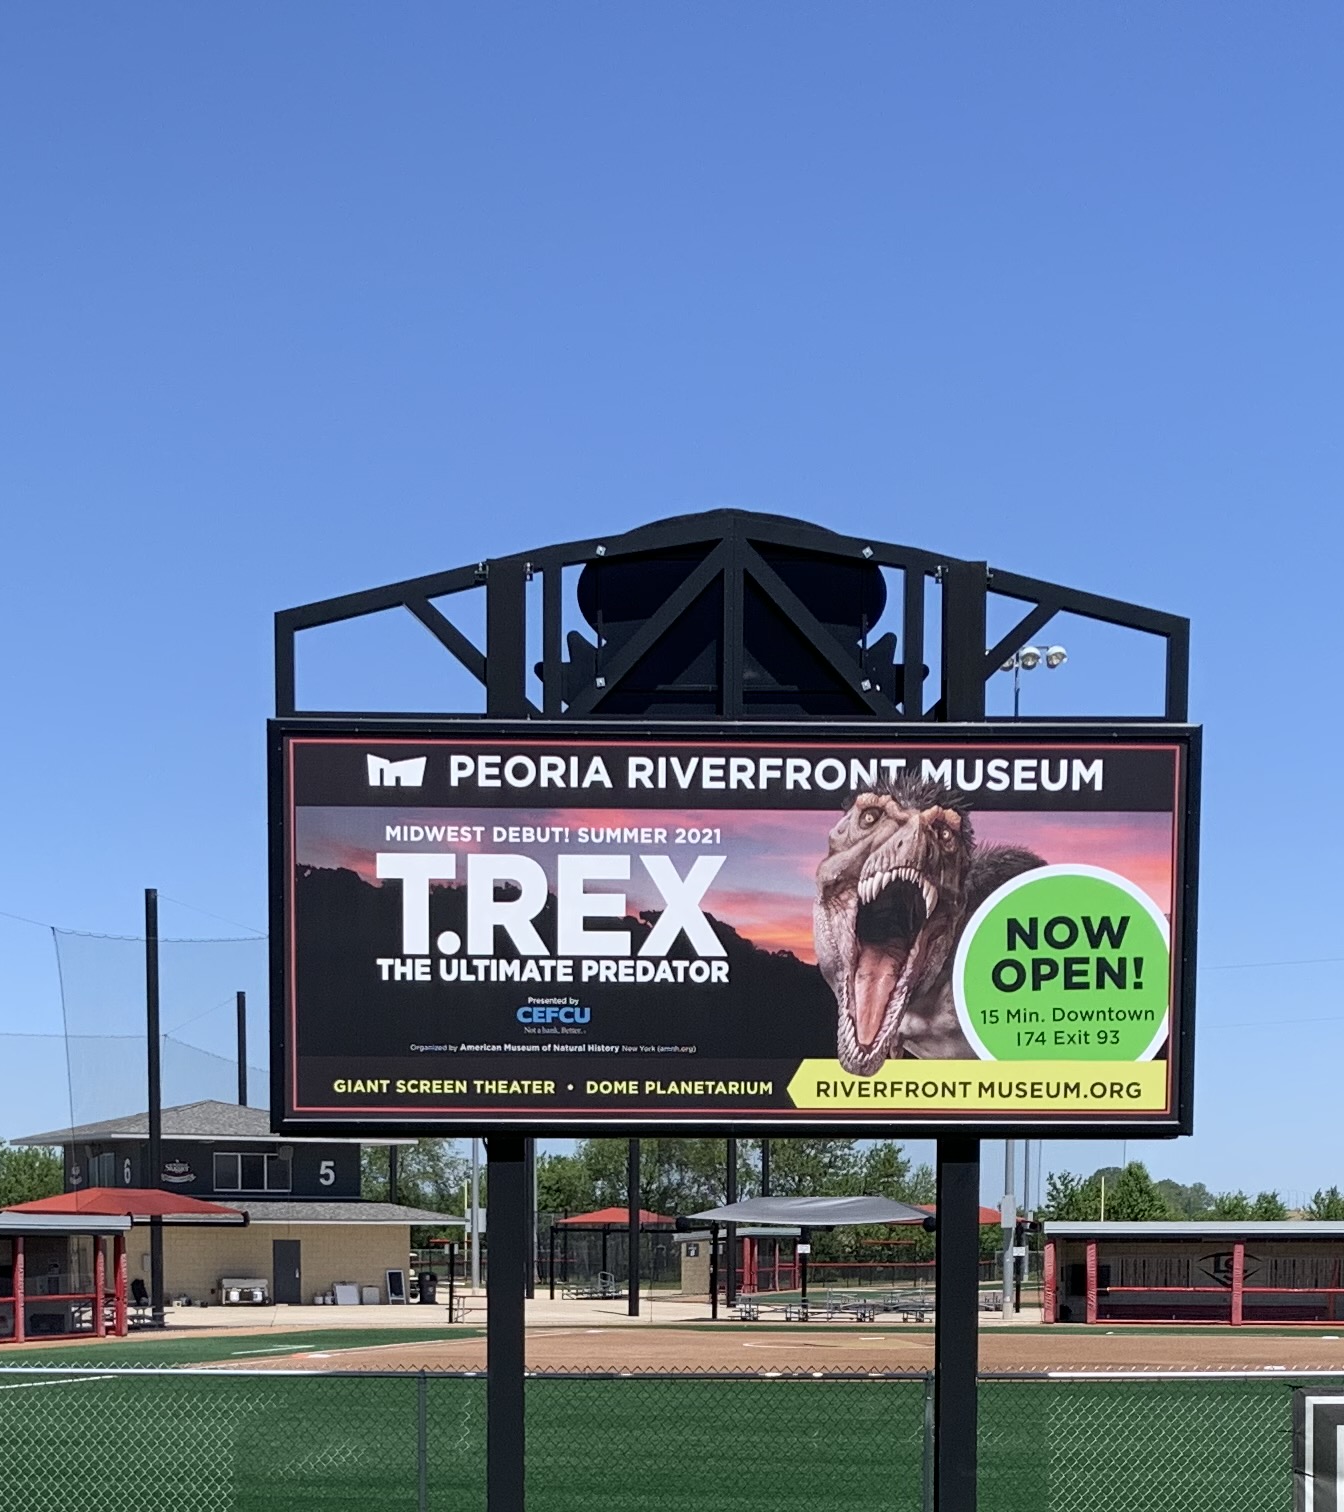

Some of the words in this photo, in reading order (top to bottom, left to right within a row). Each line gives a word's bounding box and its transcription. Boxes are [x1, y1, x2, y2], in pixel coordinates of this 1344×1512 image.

[449, 754, 613, 789] PEORIA
[628, 756, 907, 791] RIVERFRONT
[921, 758, 1104, 792] MUSEUM
[385, 825, 485, 842] MIDWEST
[493, 826, 570, 843] DEBUT!
[578, 827, 667, 844] SUMMER
[674, 828, 722, 844] 2021
[376, 853, 728, 957] T.REX
[1007, 916, 1131, 951] NOW
[376, 958, 432, 981] THE
[439, 959, 574, 982] ULTIMATE
[581, 960, 730, 983] PREDATOR
[991, 956, 1144, 993] OPEN!
[569, 997, 580, 1006] by
[516, 1006, 591, 1024] CEFCU
[981, 1009, 999, 1025] 15
[1006, 1008, 1045, 1023] Min.
[1052, 1007, 1155, 1023] Downtown
[460, 1043, 502, 1052] American
[504, 1043, 540, 1052] Museum
[542, 1043, 552, 1052] of
[553, 1044, 586, 1053] Natural
[587, 1044, 619, 1054] History
[1054, 1030, 1090, 1045] Exit
[1097, 1030, 1120, 1044] 93
[333, 1079, 391, 1094] GIANT
[395, 1079, 467, 1095] SCREEN
[473, 1080, 556, 1095] THEATER
[586, 1080, 639, 1095] DOME
[645, 1080, 774, 1095] PLANETARIUM
[123, 1158, 131, 1184] 6
[319, 1160, 336, 1186] 5
